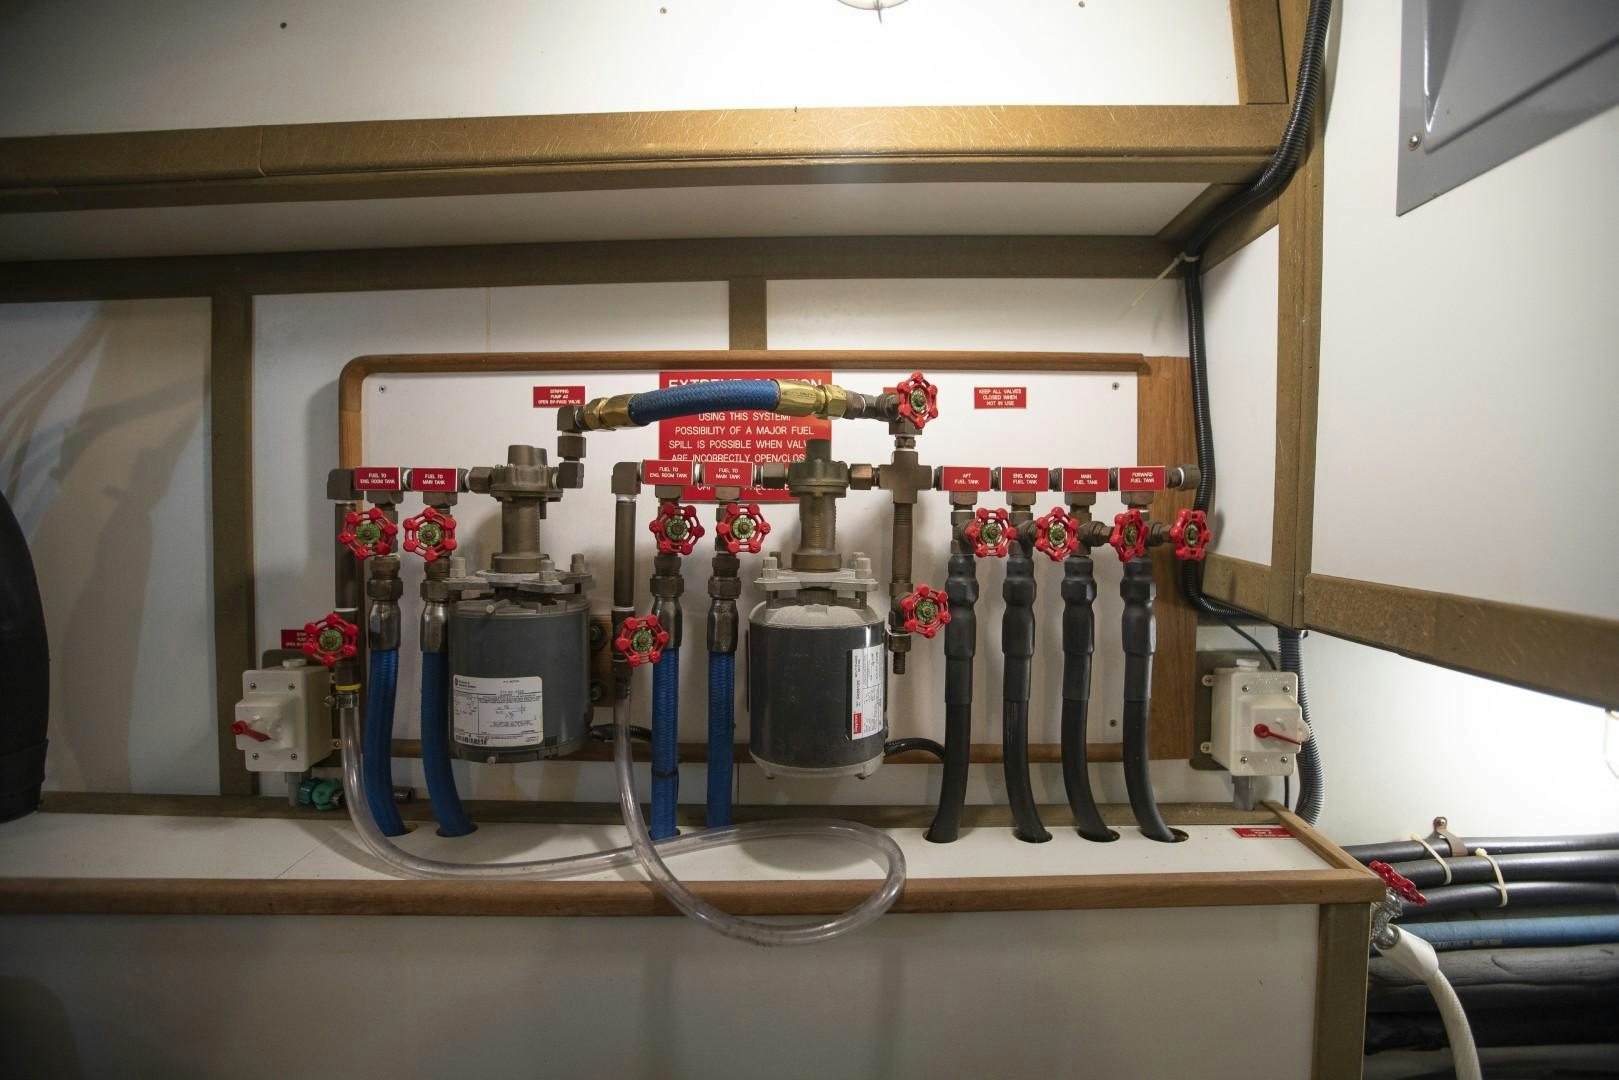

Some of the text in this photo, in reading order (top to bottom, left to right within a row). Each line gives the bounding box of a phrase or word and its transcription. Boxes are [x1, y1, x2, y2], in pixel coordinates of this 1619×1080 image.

[699, 412, 725, 421] USING
[730, 412, 748, 420] THIS
[675, 426, 814, 435] POSSIBILITY OF A MAJOR FUEL
[669, 440, 692, 449] SPILL
[697, 440, 705, 449] IS
[710, 440, 751, 449] POSSIBLE
[756, 440, 782, 448] WHEN
[692, 454, 750, 462] INCORRECTLY
